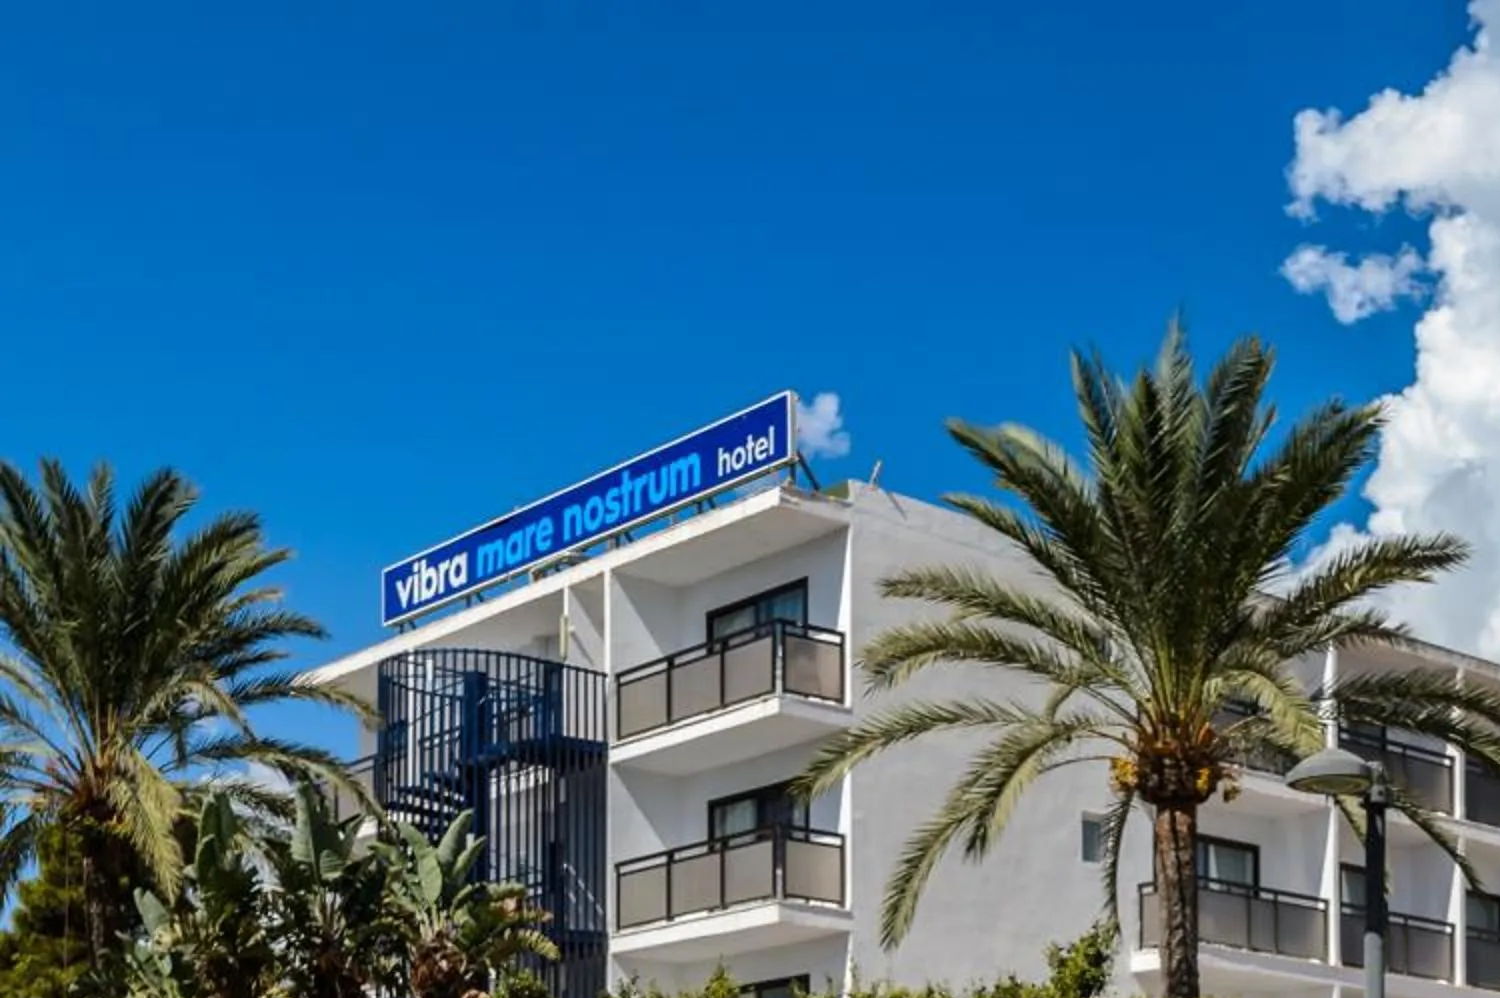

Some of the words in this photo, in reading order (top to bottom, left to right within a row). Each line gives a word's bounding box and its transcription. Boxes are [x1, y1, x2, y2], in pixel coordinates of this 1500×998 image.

[396, 552, 469, 609] vibra
[476, 517, 554, 578] mare
[563, 452, 701, 541] nostrum
[717, 425, 775, 477] hotel
